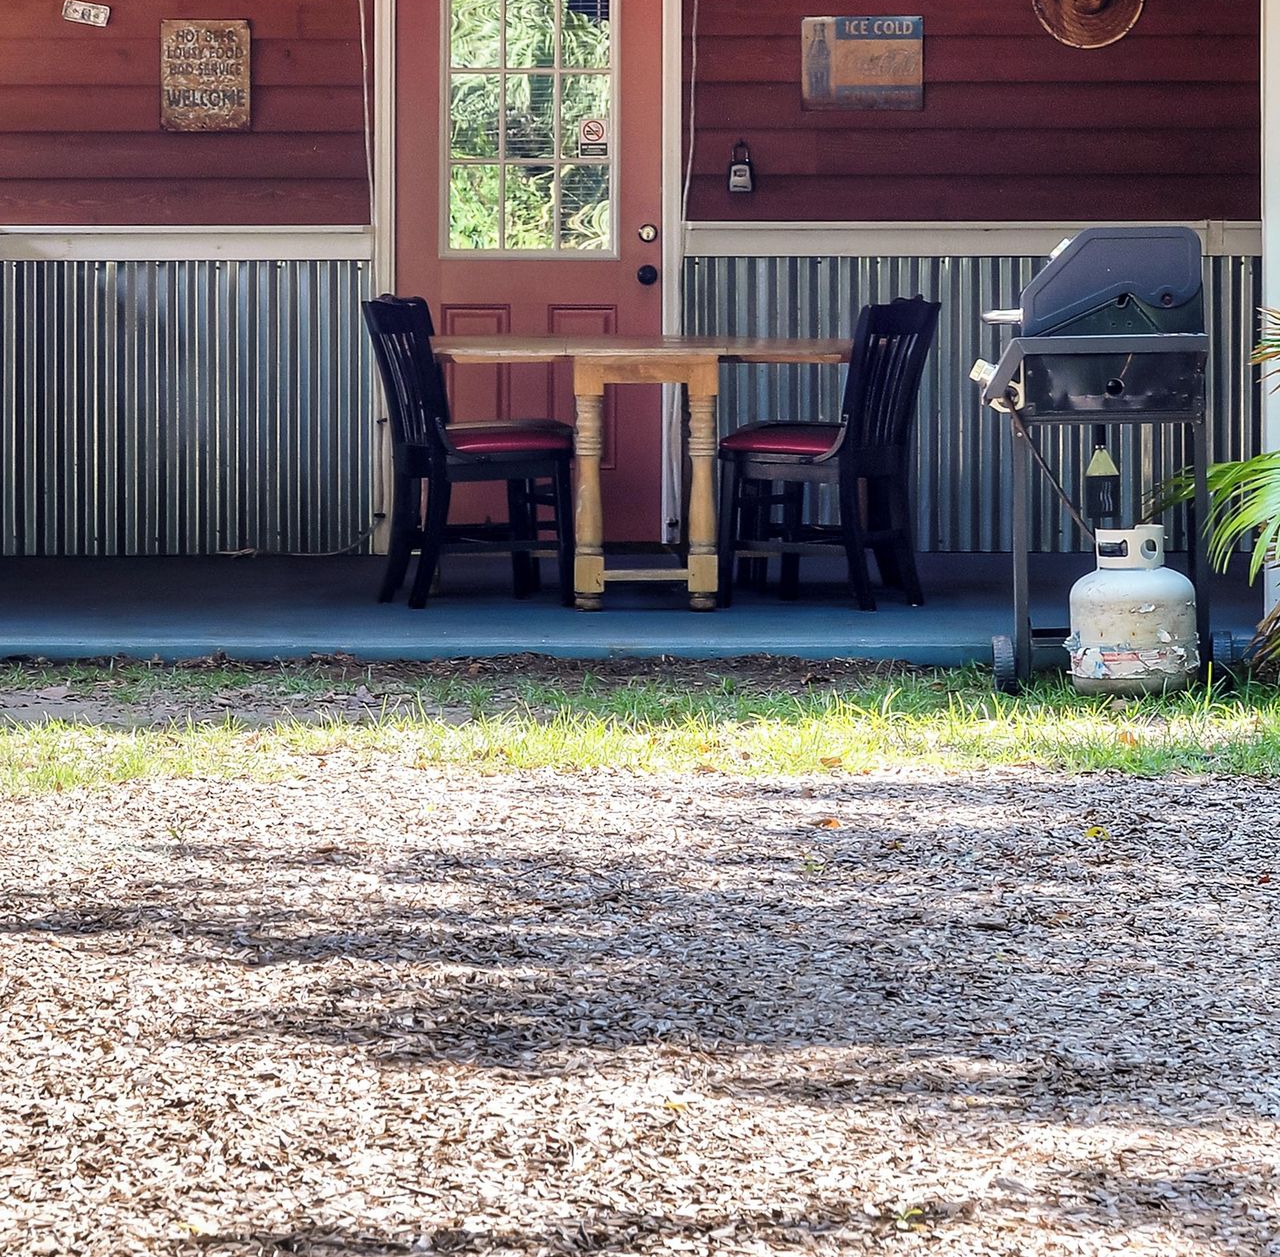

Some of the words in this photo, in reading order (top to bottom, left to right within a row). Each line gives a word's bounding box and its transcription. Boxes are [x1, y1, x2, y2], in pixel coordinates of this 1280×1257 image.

[845, 20, 869, 35] ICE
[873, 20, 913, 35] COLD
[167, 89, 245, 107] WELCOME
